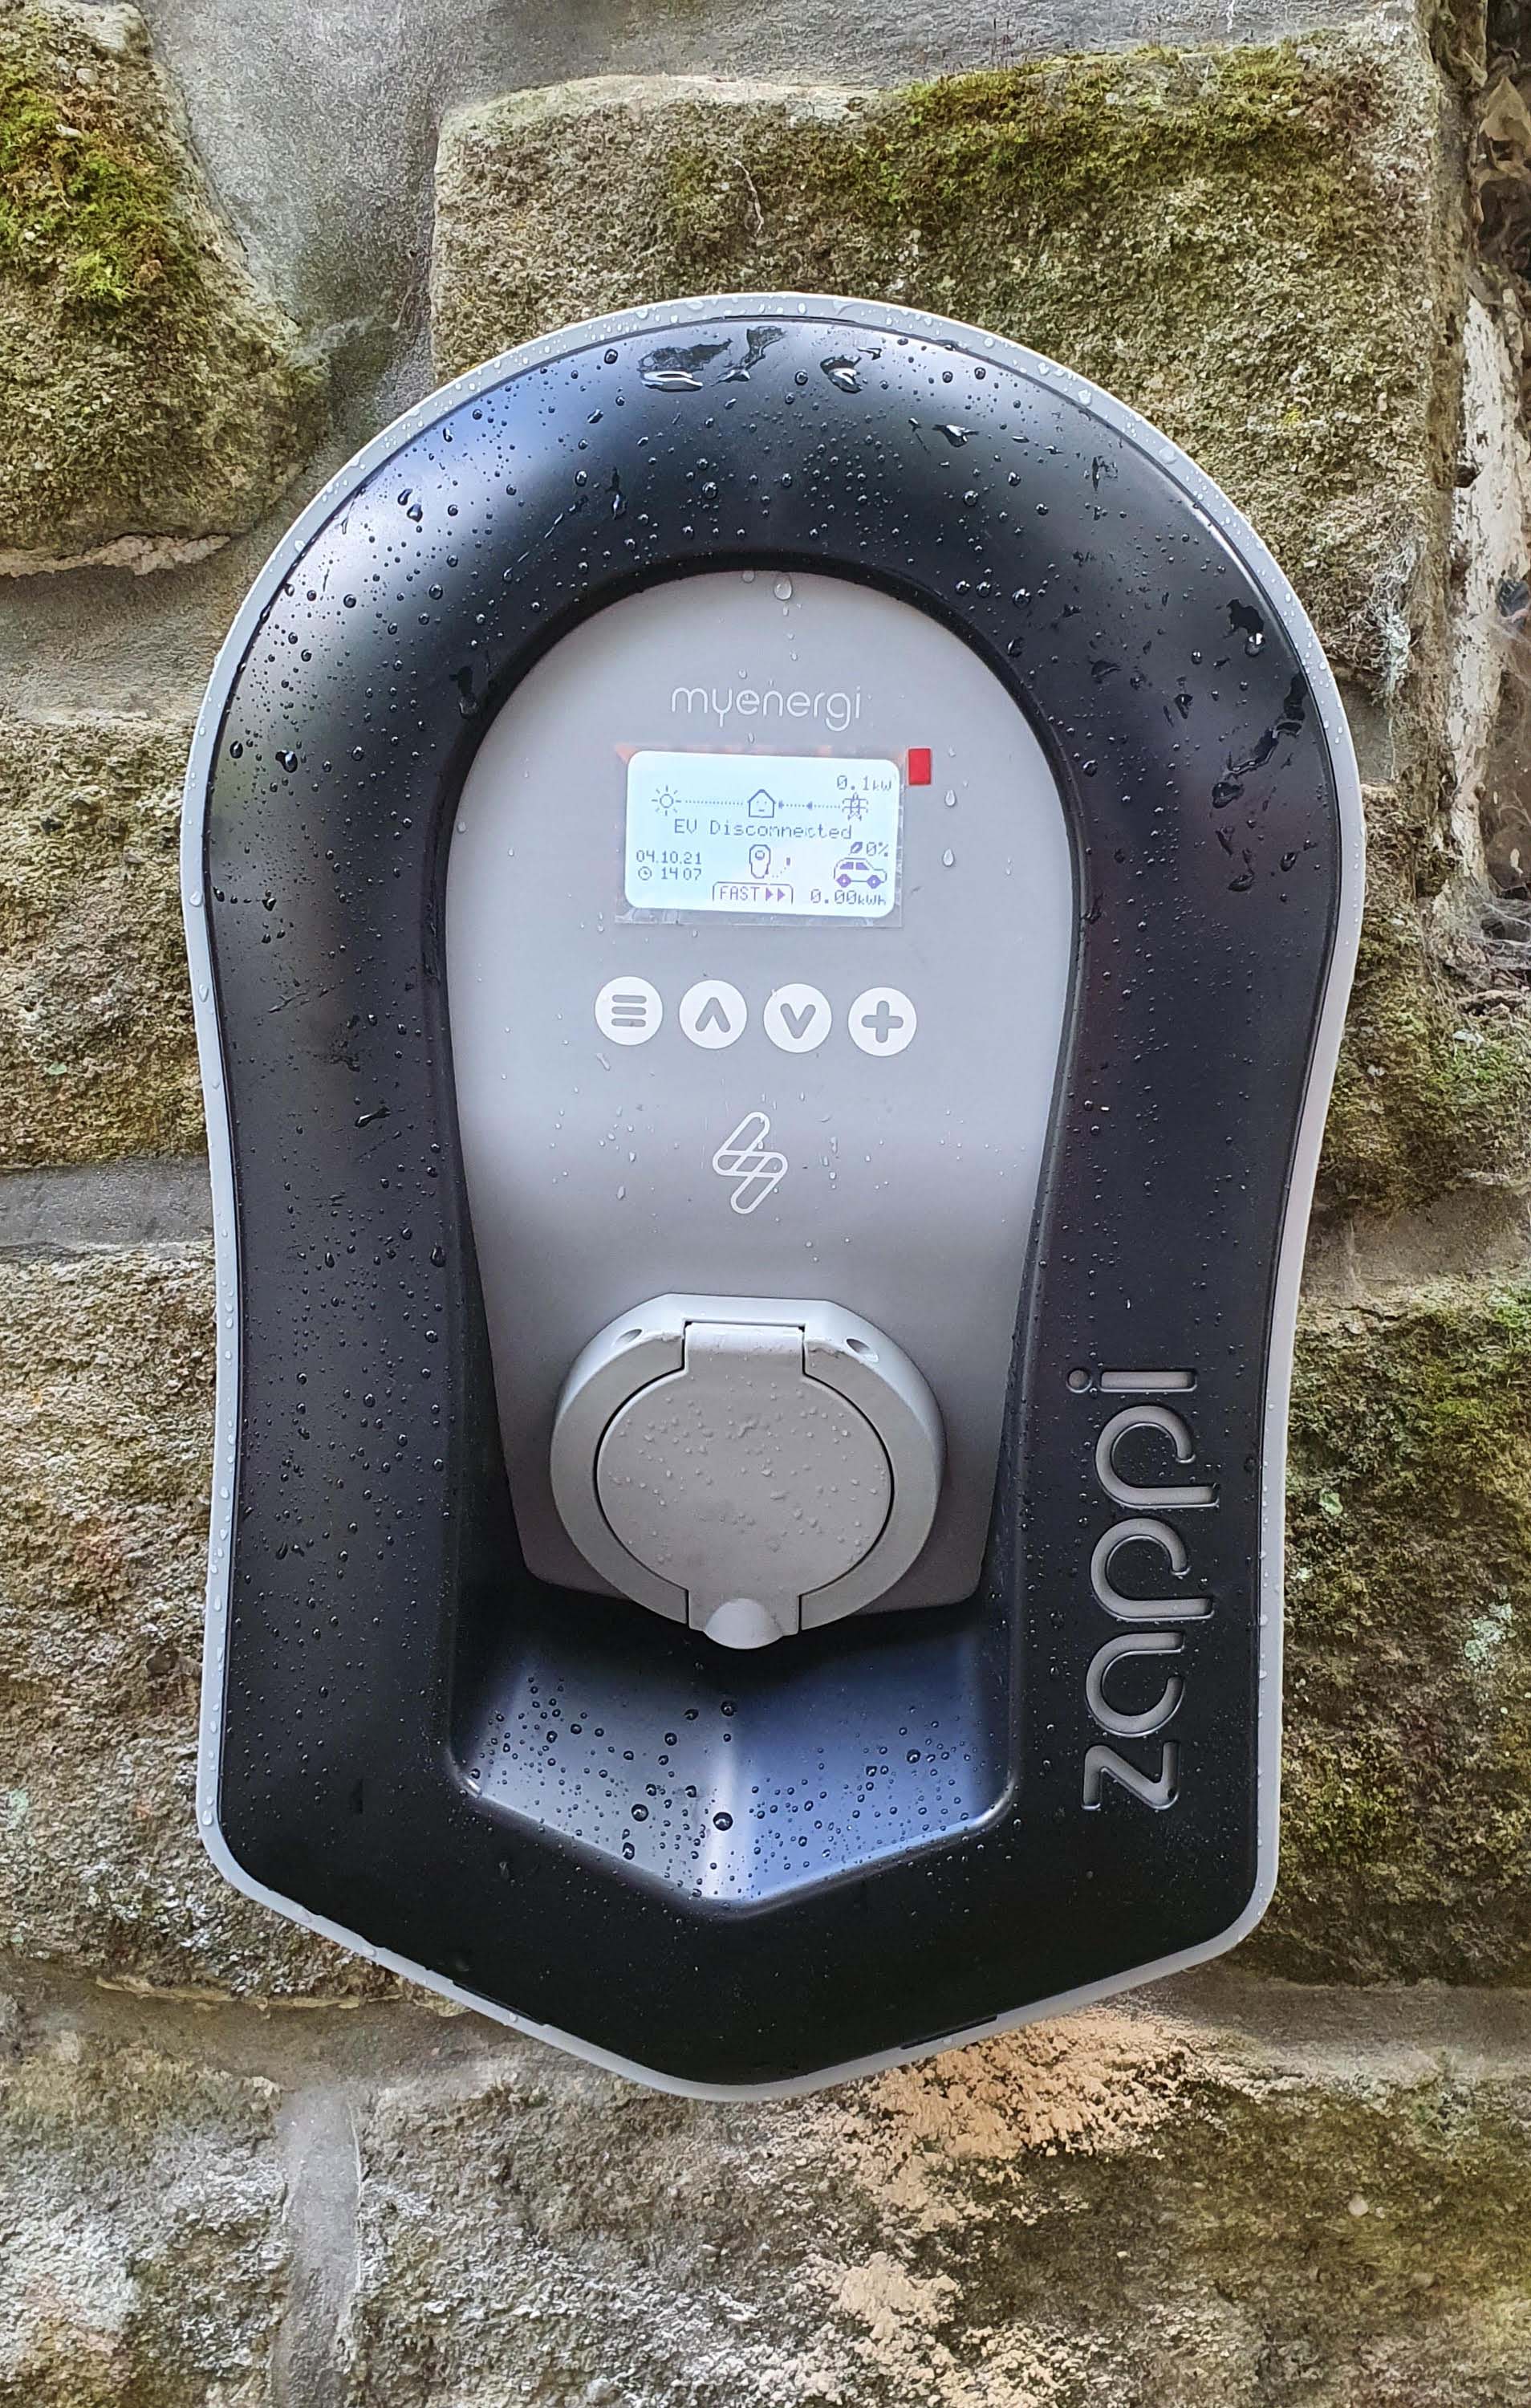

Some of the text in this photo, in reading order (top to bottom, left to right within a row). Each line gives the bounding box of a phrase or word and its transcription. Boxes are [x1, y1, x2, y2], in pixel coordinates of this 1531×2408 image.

[671, 685, 862, 731] myenergi
[674, 818, 852, 840] EV Disconnected
[636, 849, 702, 865] 04.10.21
[866, 841, 889, 857] 0%
[719, 886, 761, 901] FAST
[1067, 1369, 1219, 1810] zappi
